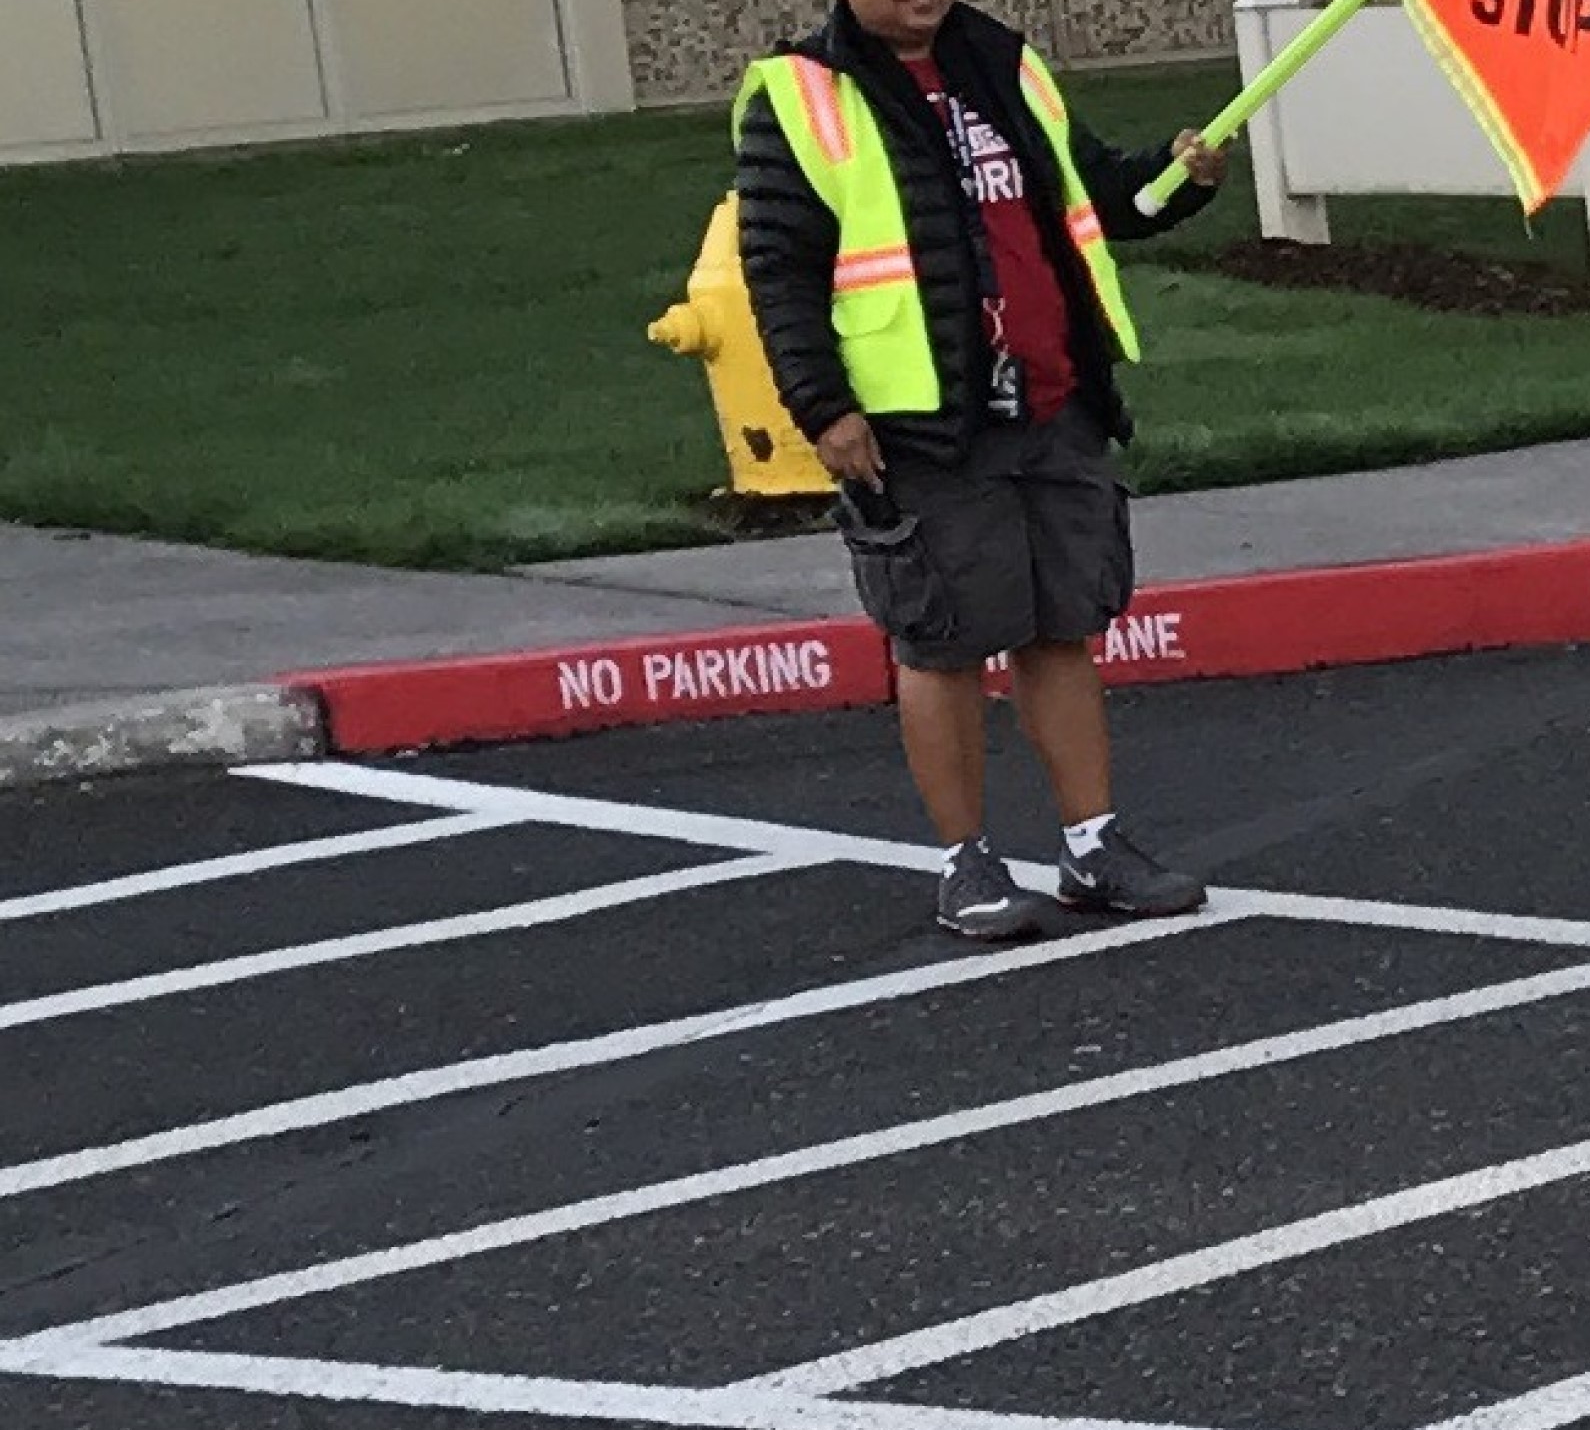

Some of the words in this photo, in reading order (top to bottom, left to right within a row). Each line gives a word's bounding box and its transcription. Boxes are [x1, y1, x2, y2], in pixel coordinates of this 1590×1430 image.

[558, 659, 622, 709] NO
[643, 640, 832, 702] PARKING
[1093, 613, 1186, 664] ANE
